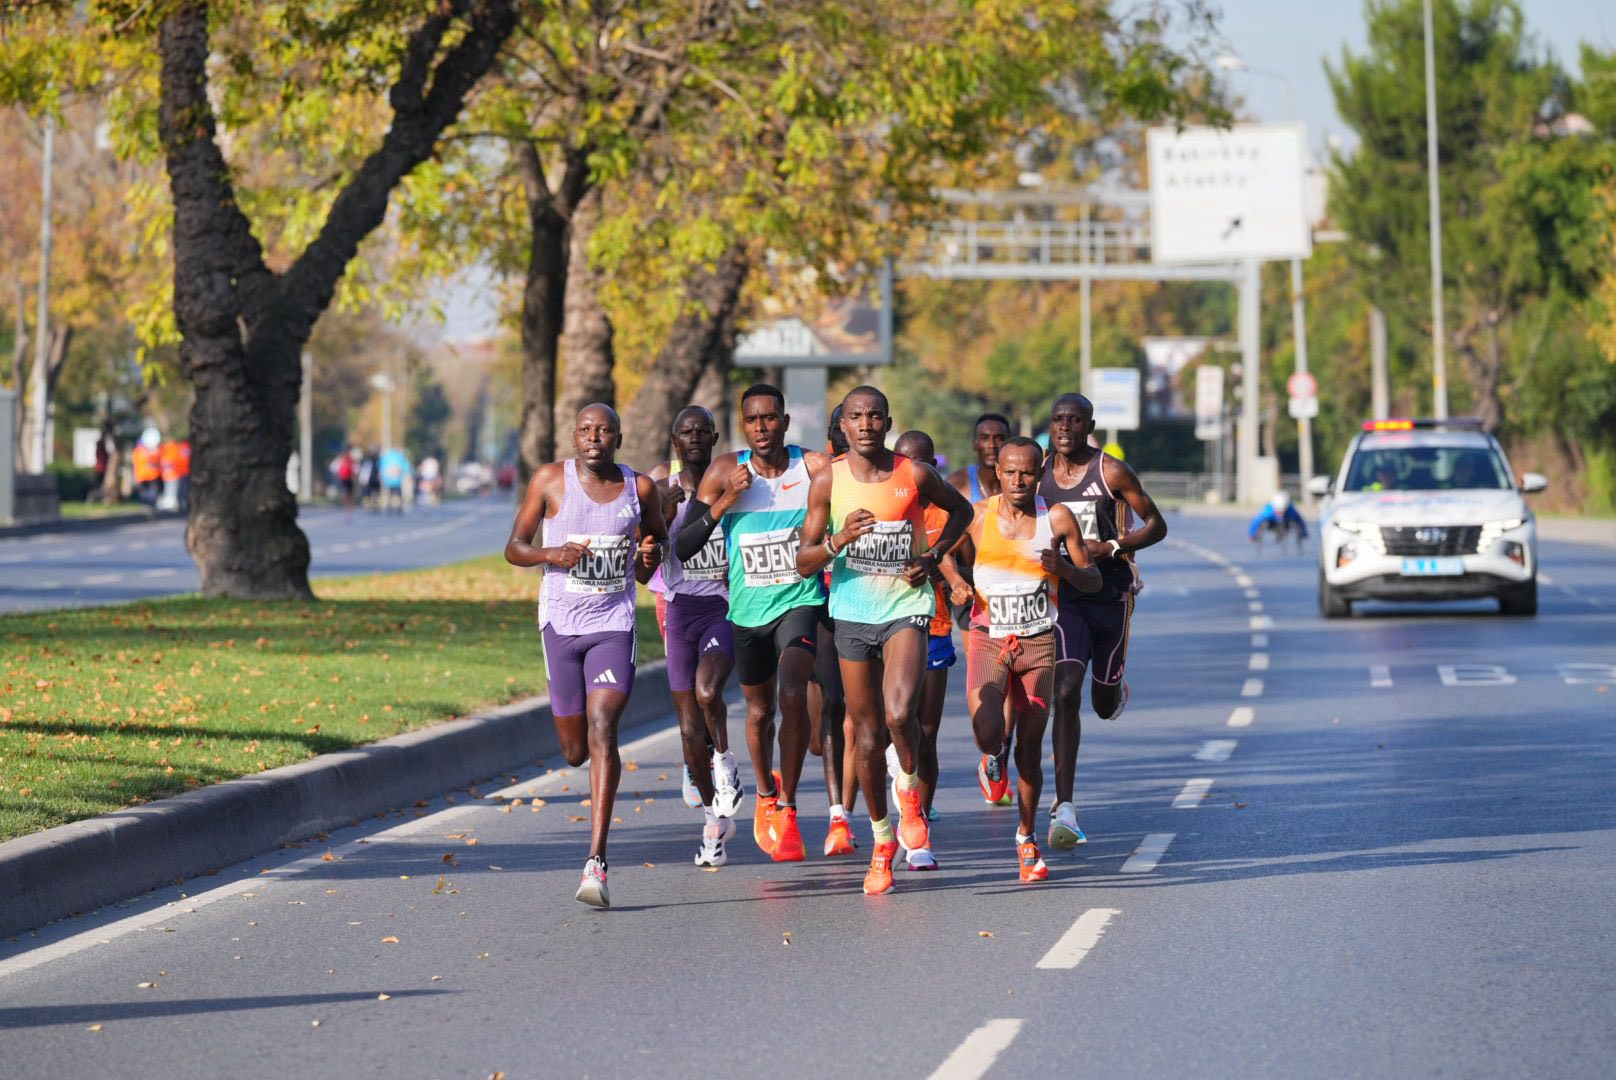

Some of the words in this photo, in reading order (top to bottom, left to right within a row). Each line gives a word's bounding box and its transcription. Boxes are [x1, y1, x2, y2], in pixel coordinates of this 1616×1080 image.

[904, 524, 913, 532] 91
[848, 532, 911, 560] CHRISTOPHER
[852, 558, 876, 567] ISTANBUL
[990, 592, 1048, 625] SUFARO
